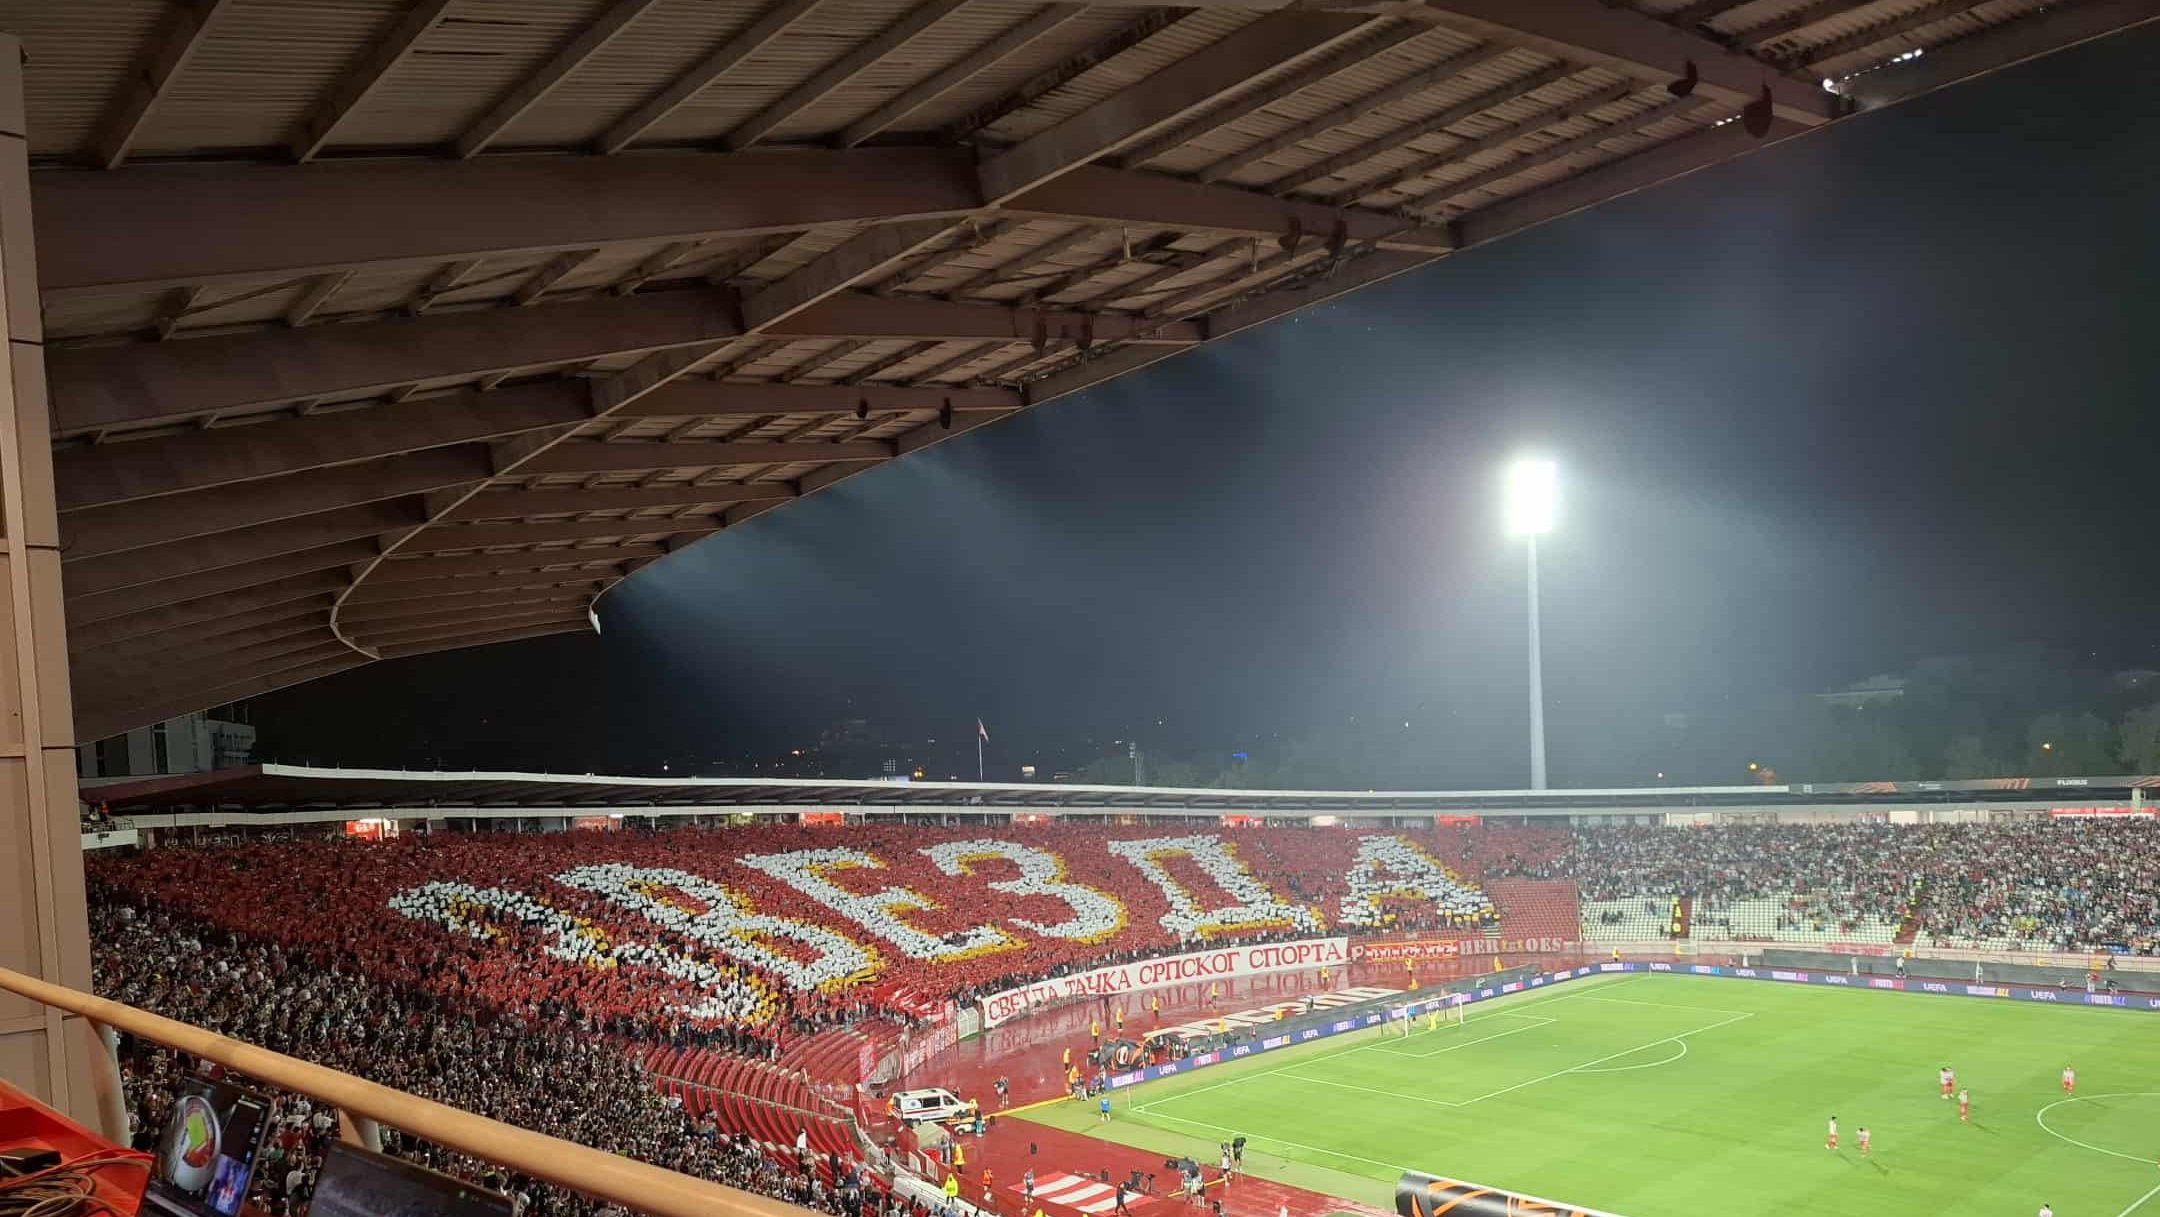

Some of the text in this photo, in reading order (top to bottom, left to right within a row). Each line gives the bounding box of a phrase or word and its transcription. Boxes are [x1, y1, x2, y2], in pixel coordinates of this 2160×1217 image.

[1064, 969, 1132, 996] ТАЧКА
[1139, 952, 1240, 984] СРПСКОГ
[1249, 943, 1343, 969] СПОРТА
[1923, 982, 1948, 992] UEFA
[2030, 990, 2057, 1001] UEFA
[1233, 1045, 1251, 1057] UEFA
[1159, 1064, 1177, 1076] UEFA
